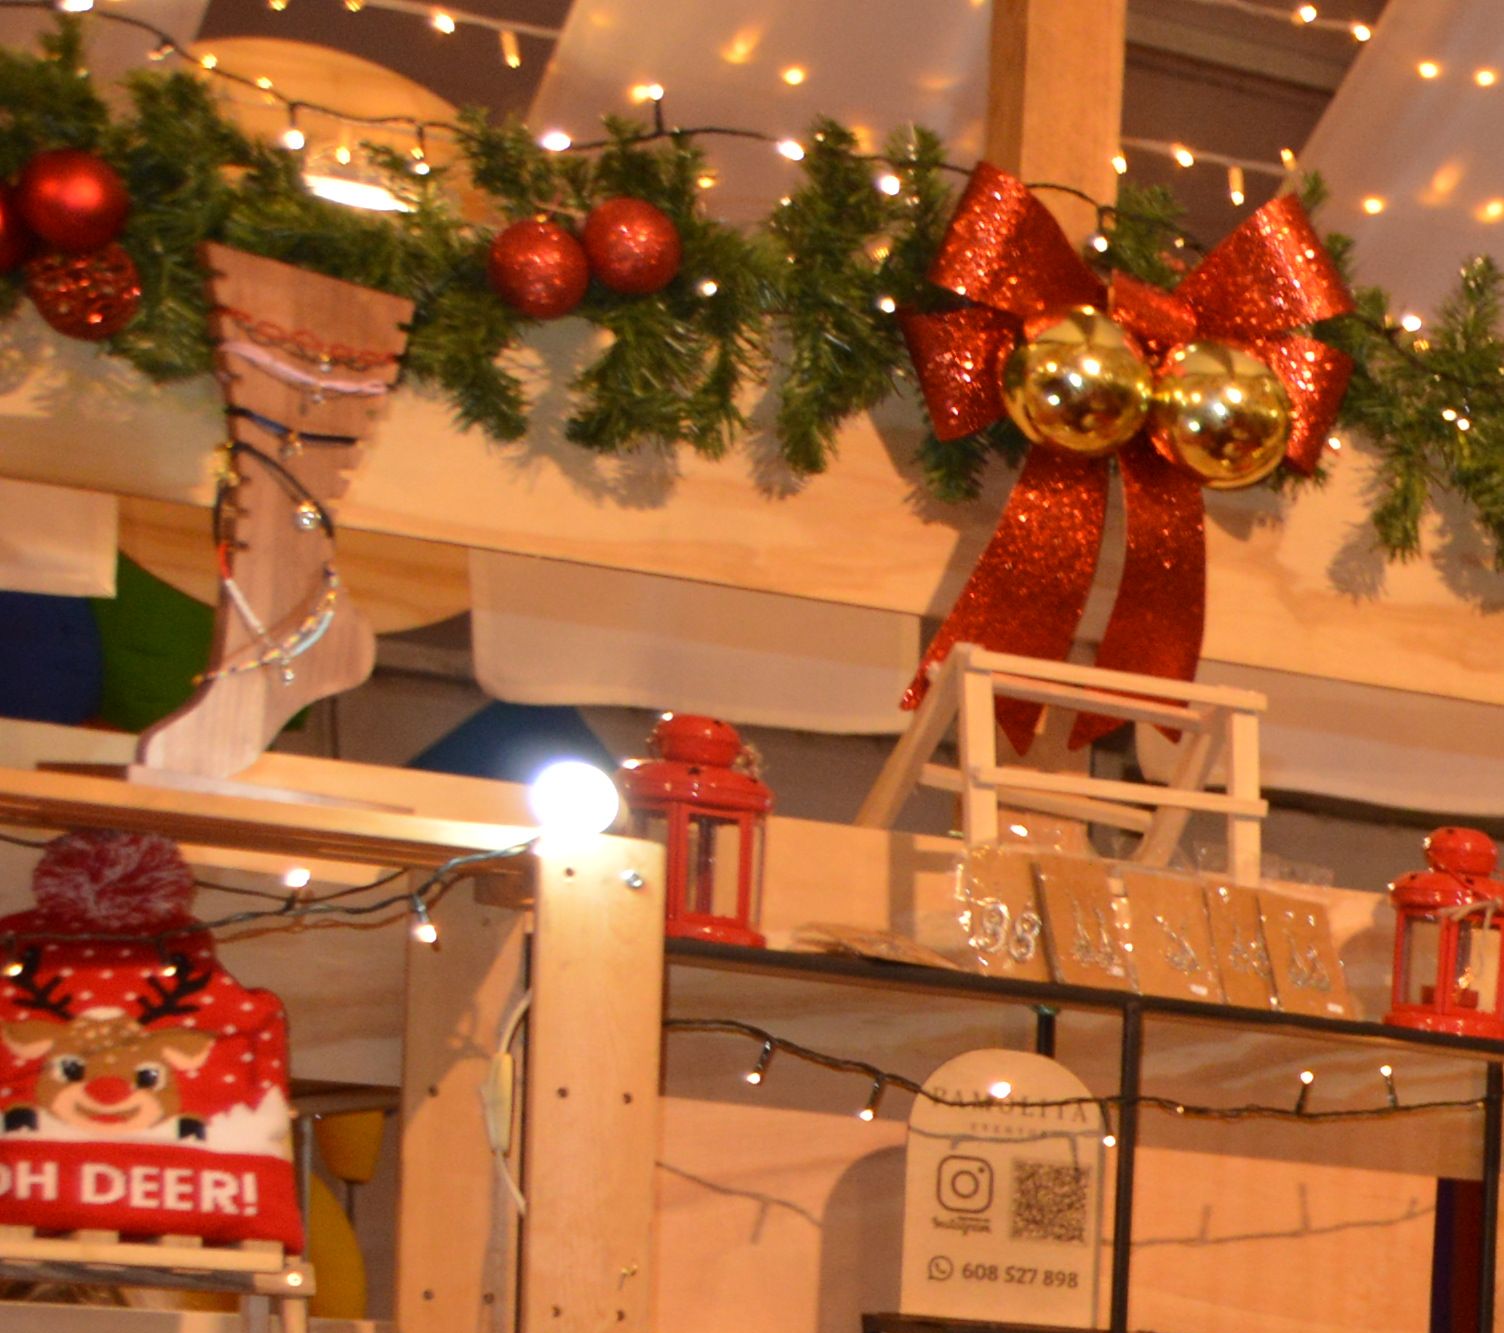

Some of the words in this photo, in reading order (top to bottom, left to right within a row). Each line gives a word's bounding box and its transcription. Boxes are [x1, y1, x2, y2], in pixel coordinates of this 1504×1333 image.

[0, 1160, 59, 1201] H
[80, 1162, 259, 1217] DEER!
[962, 1263, 998, 1282] 608
[1004, 1265, 1038, 1285] 527
[1043, 1268, 1079, 1289] 898
